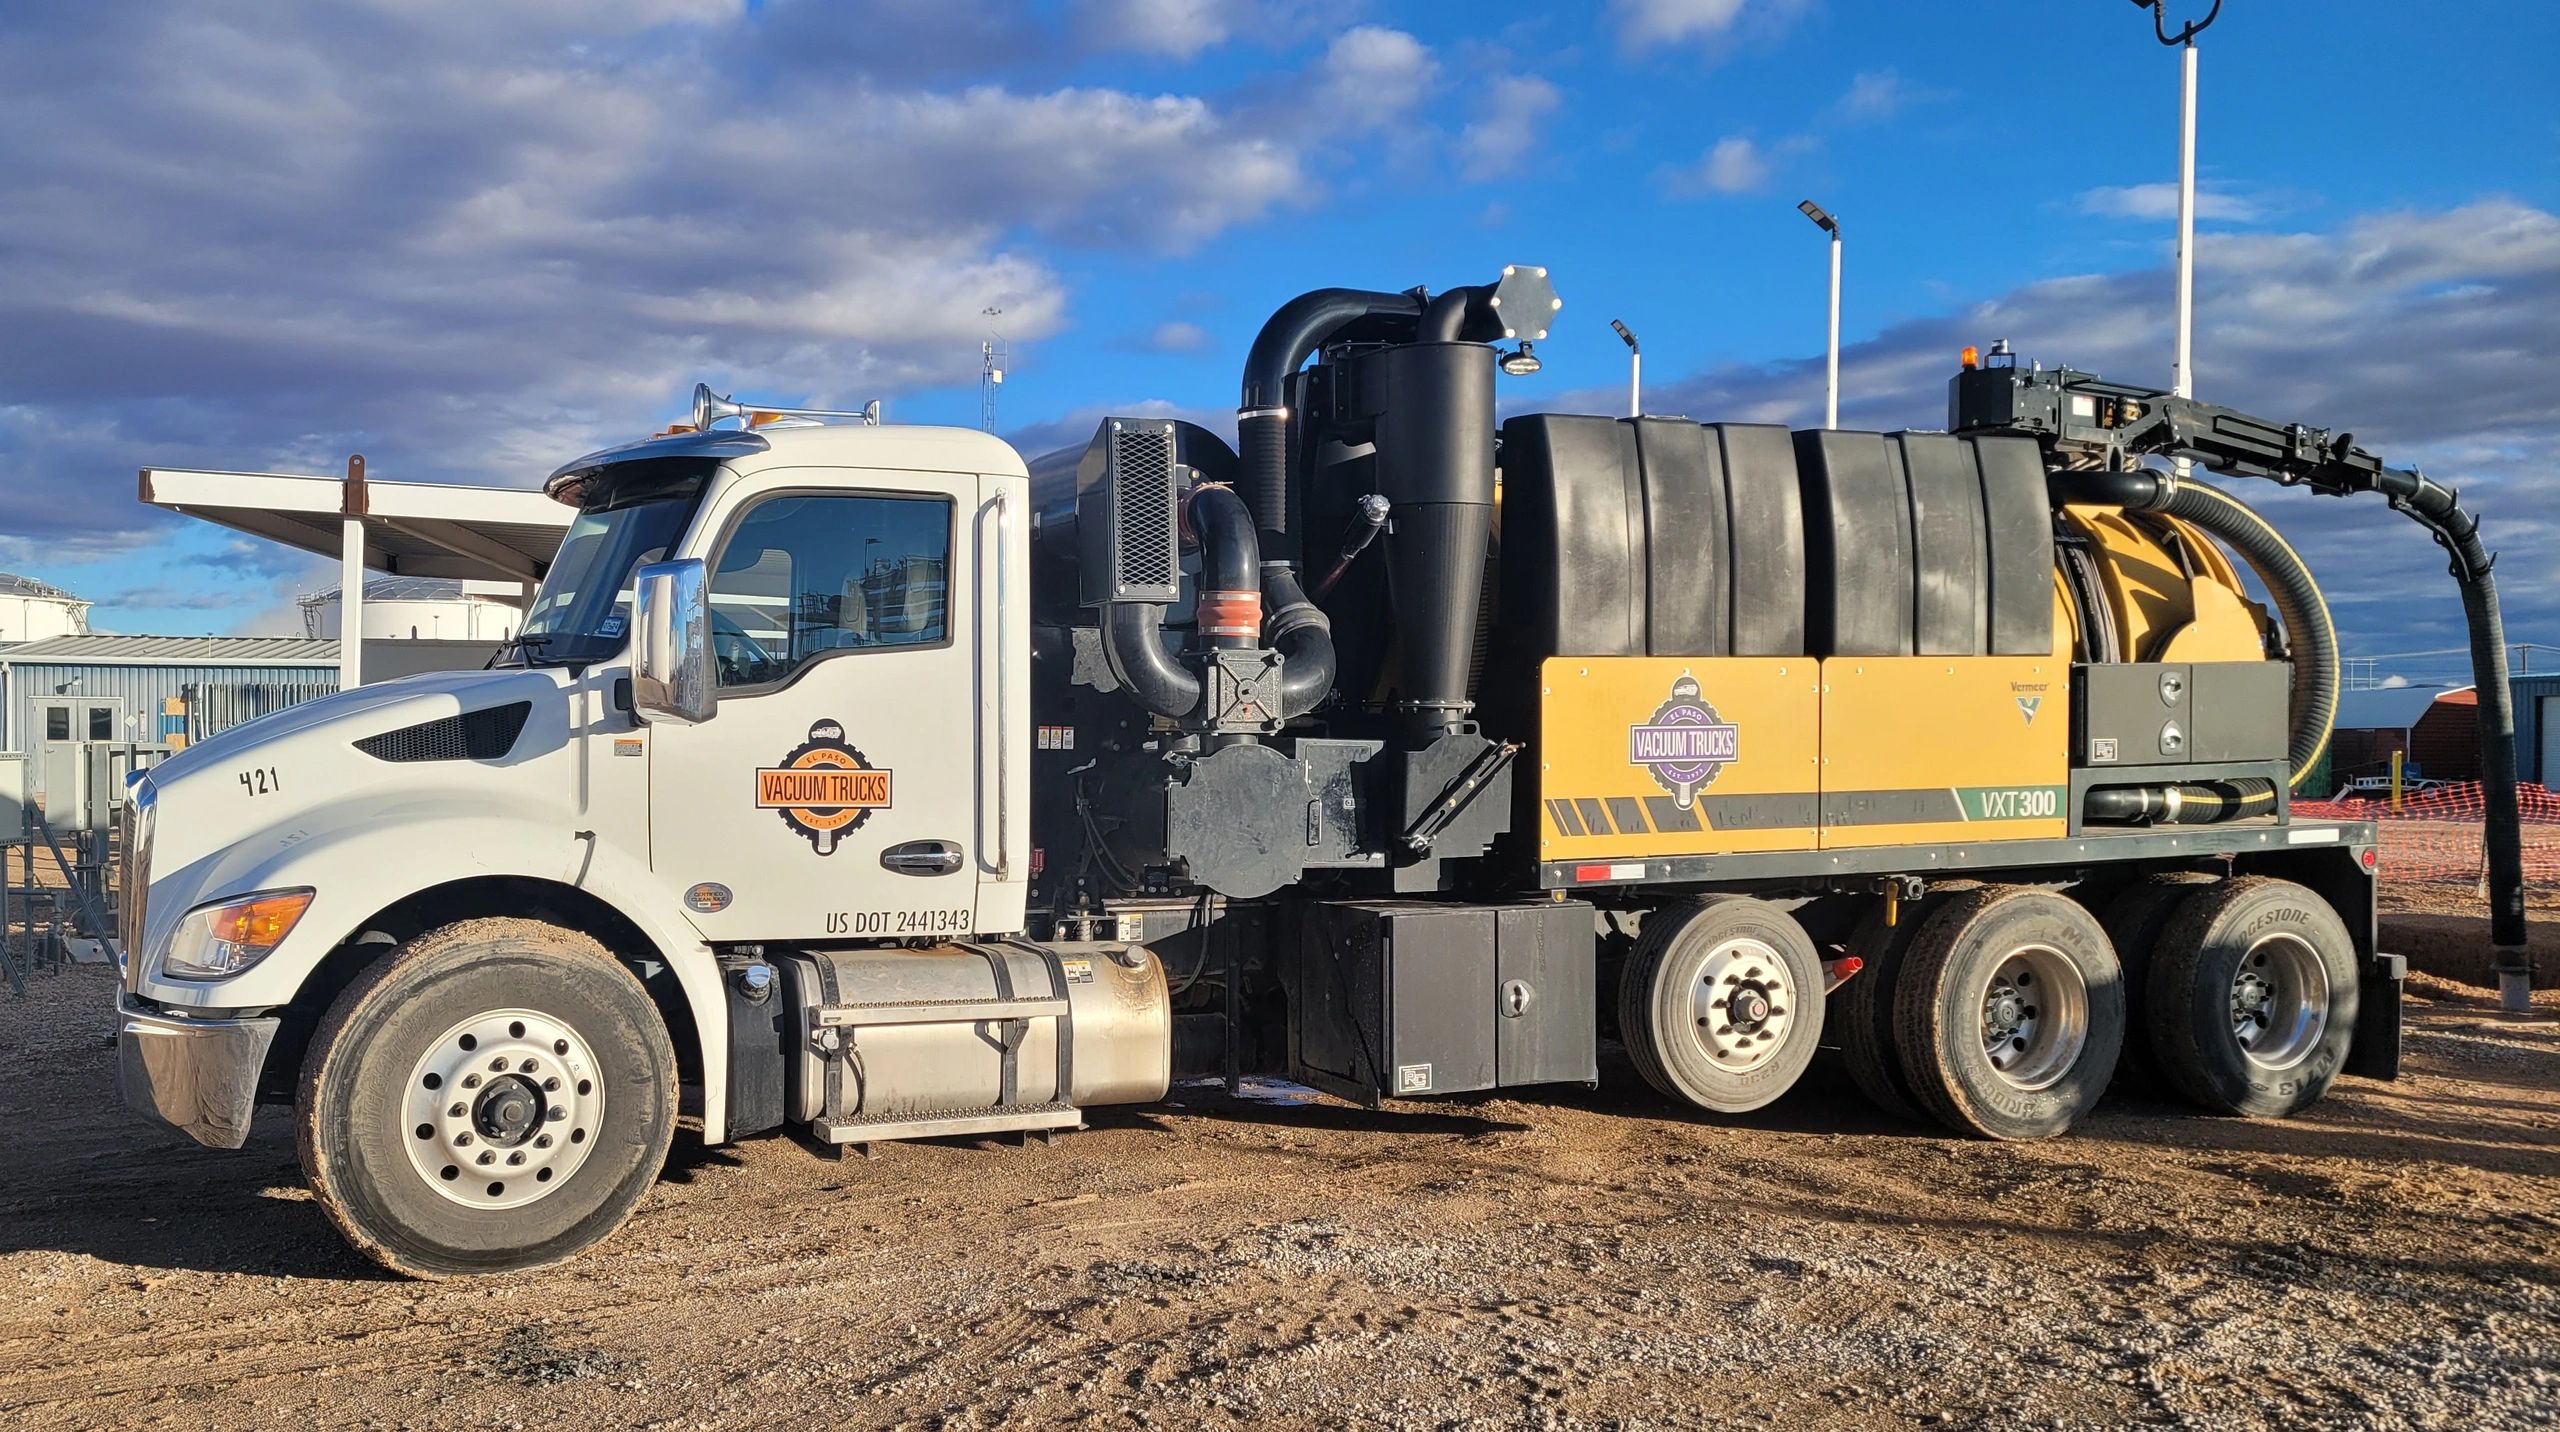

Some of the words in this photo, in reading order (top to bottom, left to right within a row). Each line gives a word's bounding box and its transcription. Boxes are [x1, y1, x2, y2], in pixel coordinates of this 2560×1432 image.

[2011, 681, 2048, 692] Vermeer
[1669, 712, 1680, 720] EL
[1682, 709, 1702, 720] PASO
[1636, 731, 1687, 757] VACUUM
[1689, 730, 1734, 756] TRUCKS
[806, 754, 818, 764] EL
[821, 752, 847, 765] PASO
[239, 766, 280, 797] 421
[763, 774, 827, 801] VACUUM
[831, 775, 886, 801] TRUCKS
[1981, 790, 2056, 818] VXT300
[826, 912, 849, 934] US
[855, 911, 892, 933] DOT
[896, 909, 970, 932] 2441343
